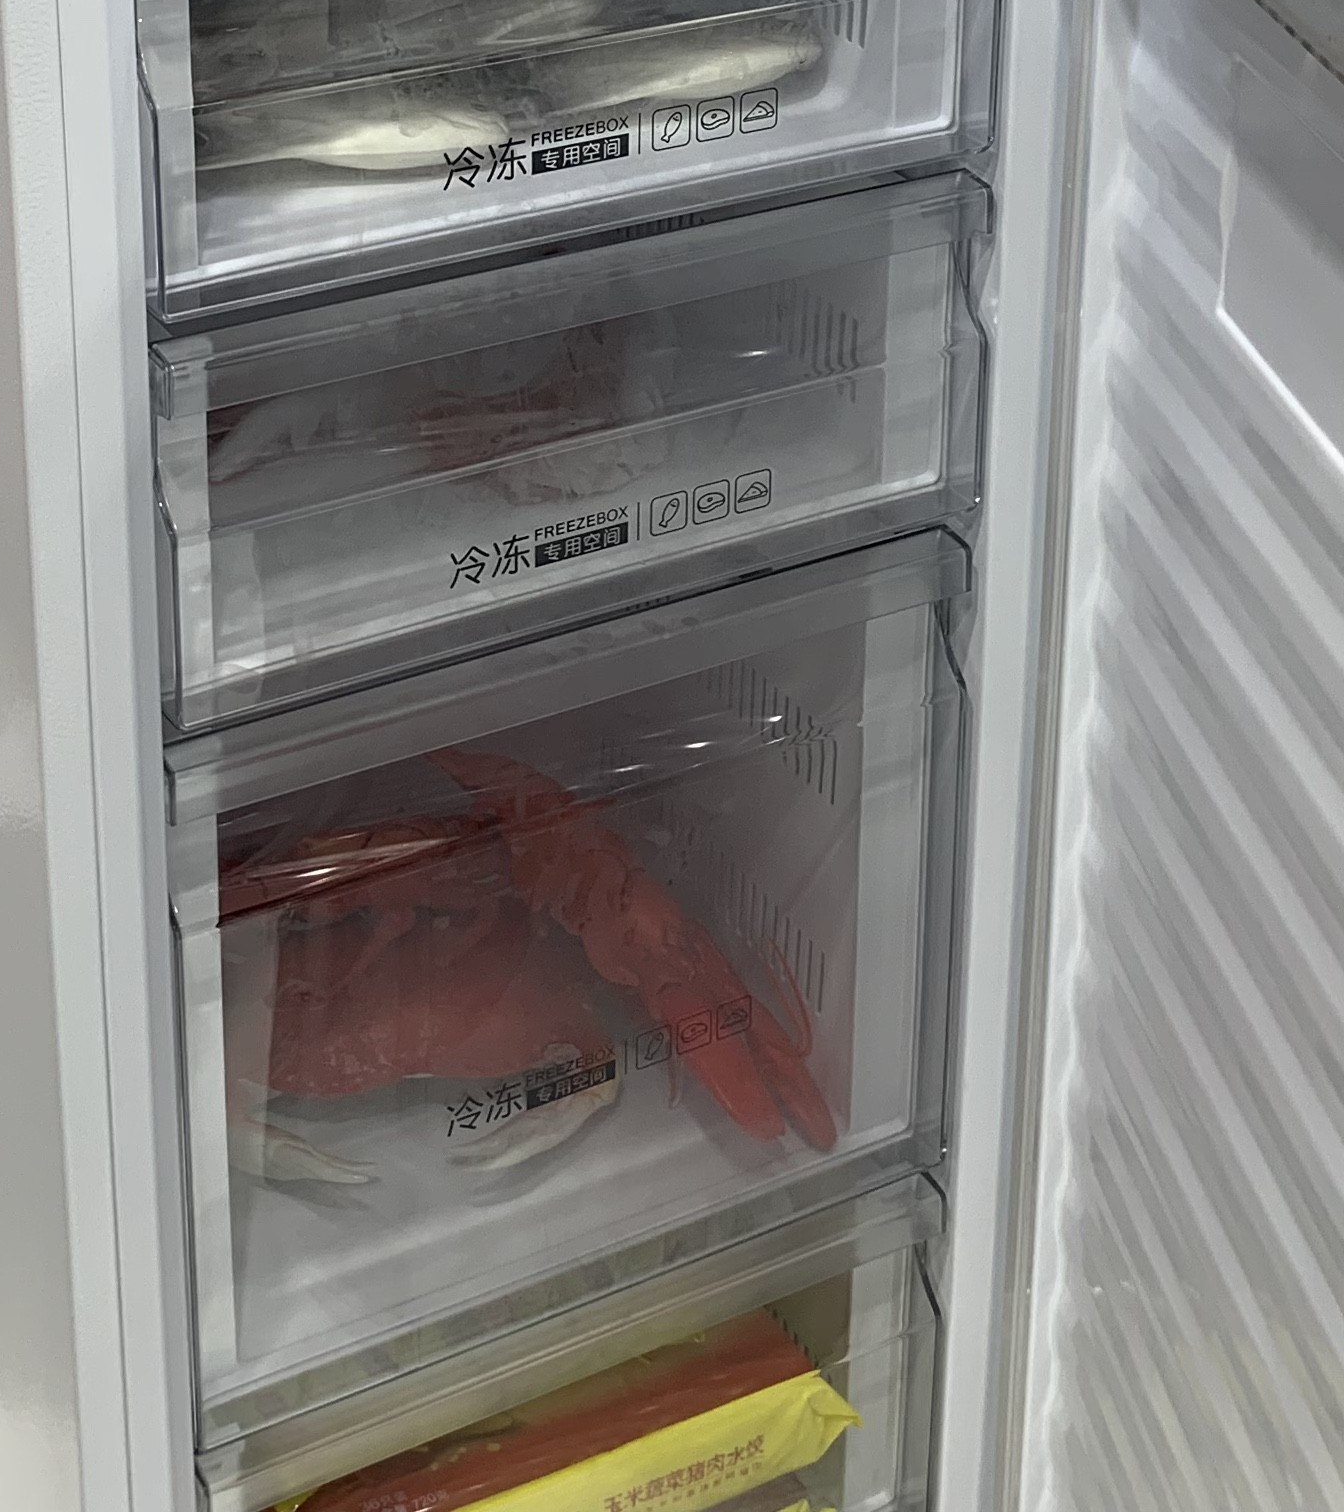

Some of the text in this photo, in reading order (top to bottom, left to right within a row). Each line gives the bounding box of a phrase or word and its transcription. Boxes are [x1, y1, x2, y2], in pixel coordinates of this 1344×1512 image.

[530, 116, 630, 148] FREEZEBOX
[443, 136, 529, 192] 冷冻
[539, 136, 623, 171] 专用空间
[533, 505, 630, 543] FREEZEBOX
[449, 533, 532, 589] 冷冻
[542, 525, 623, 562] 专用空间
[525, 1045, 617, 1088] FREEZEBOX
[535, 1067, 608, 1104] 专用空间
[445, 1081, 524, 1138] 冷冻
